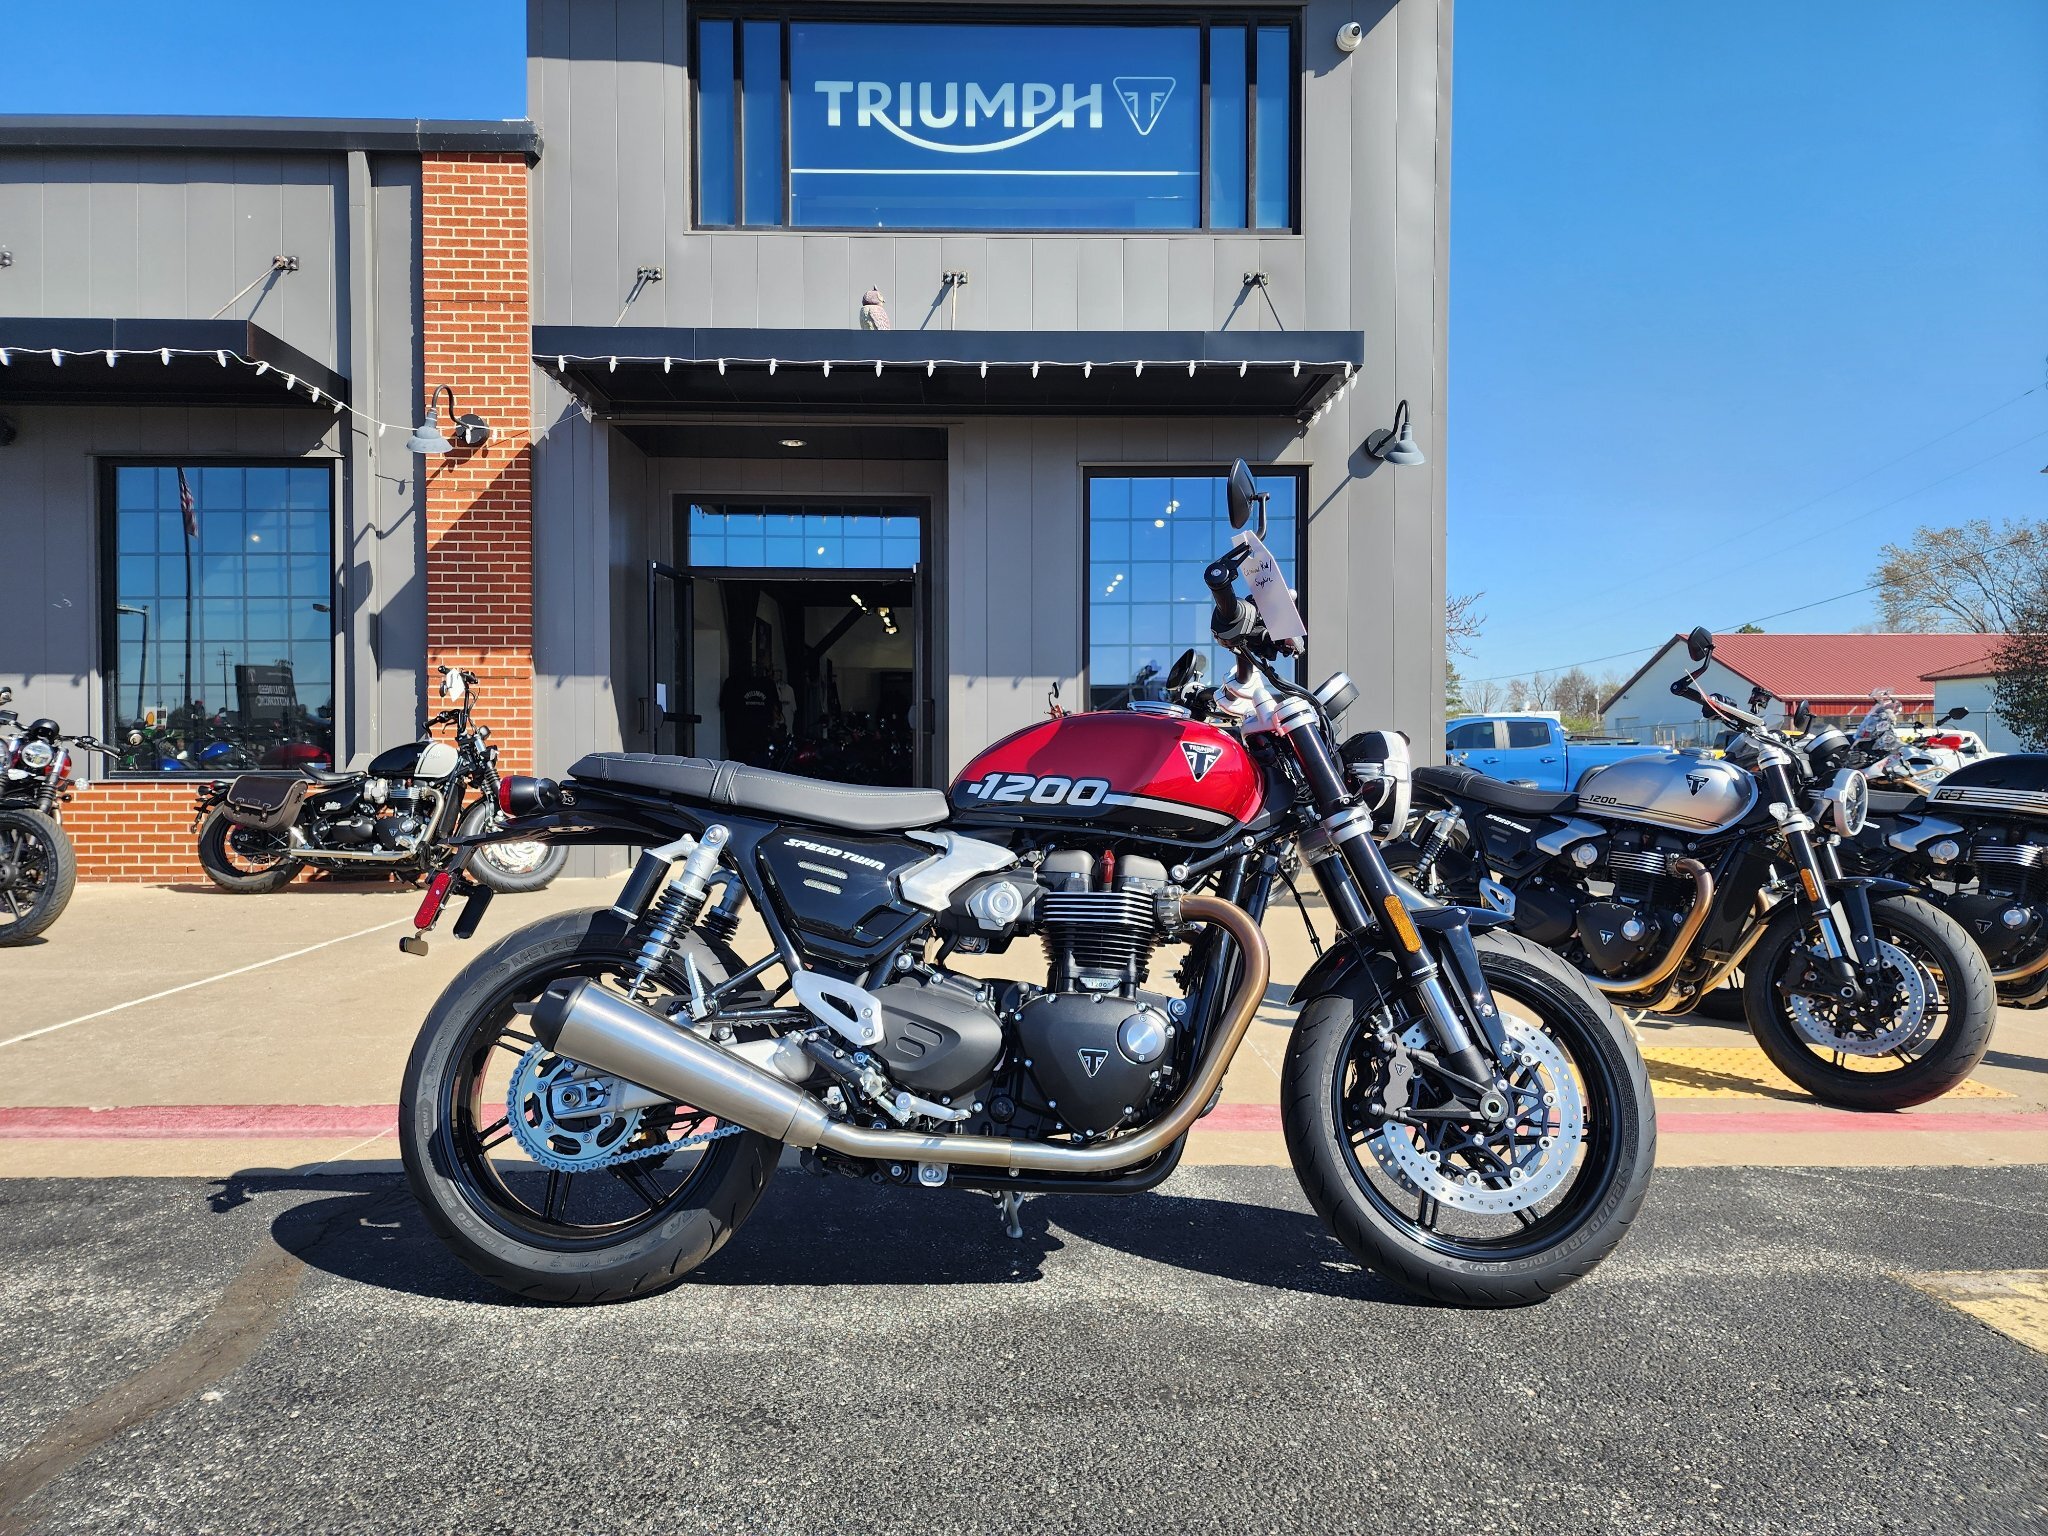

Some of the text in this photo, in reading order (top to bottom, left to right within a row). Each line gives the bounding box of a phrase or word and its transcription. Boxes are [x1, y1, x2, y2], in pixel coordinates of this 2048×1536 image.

[815, 80, 1103, 153] TRIUMPH
[977, 774, 1109, 807] 1200
[1589, 794, 1618, 805] 1200
[1936, 789, 1963, 800] RS
[783, 838, 886, 871] SPEED TWIN
